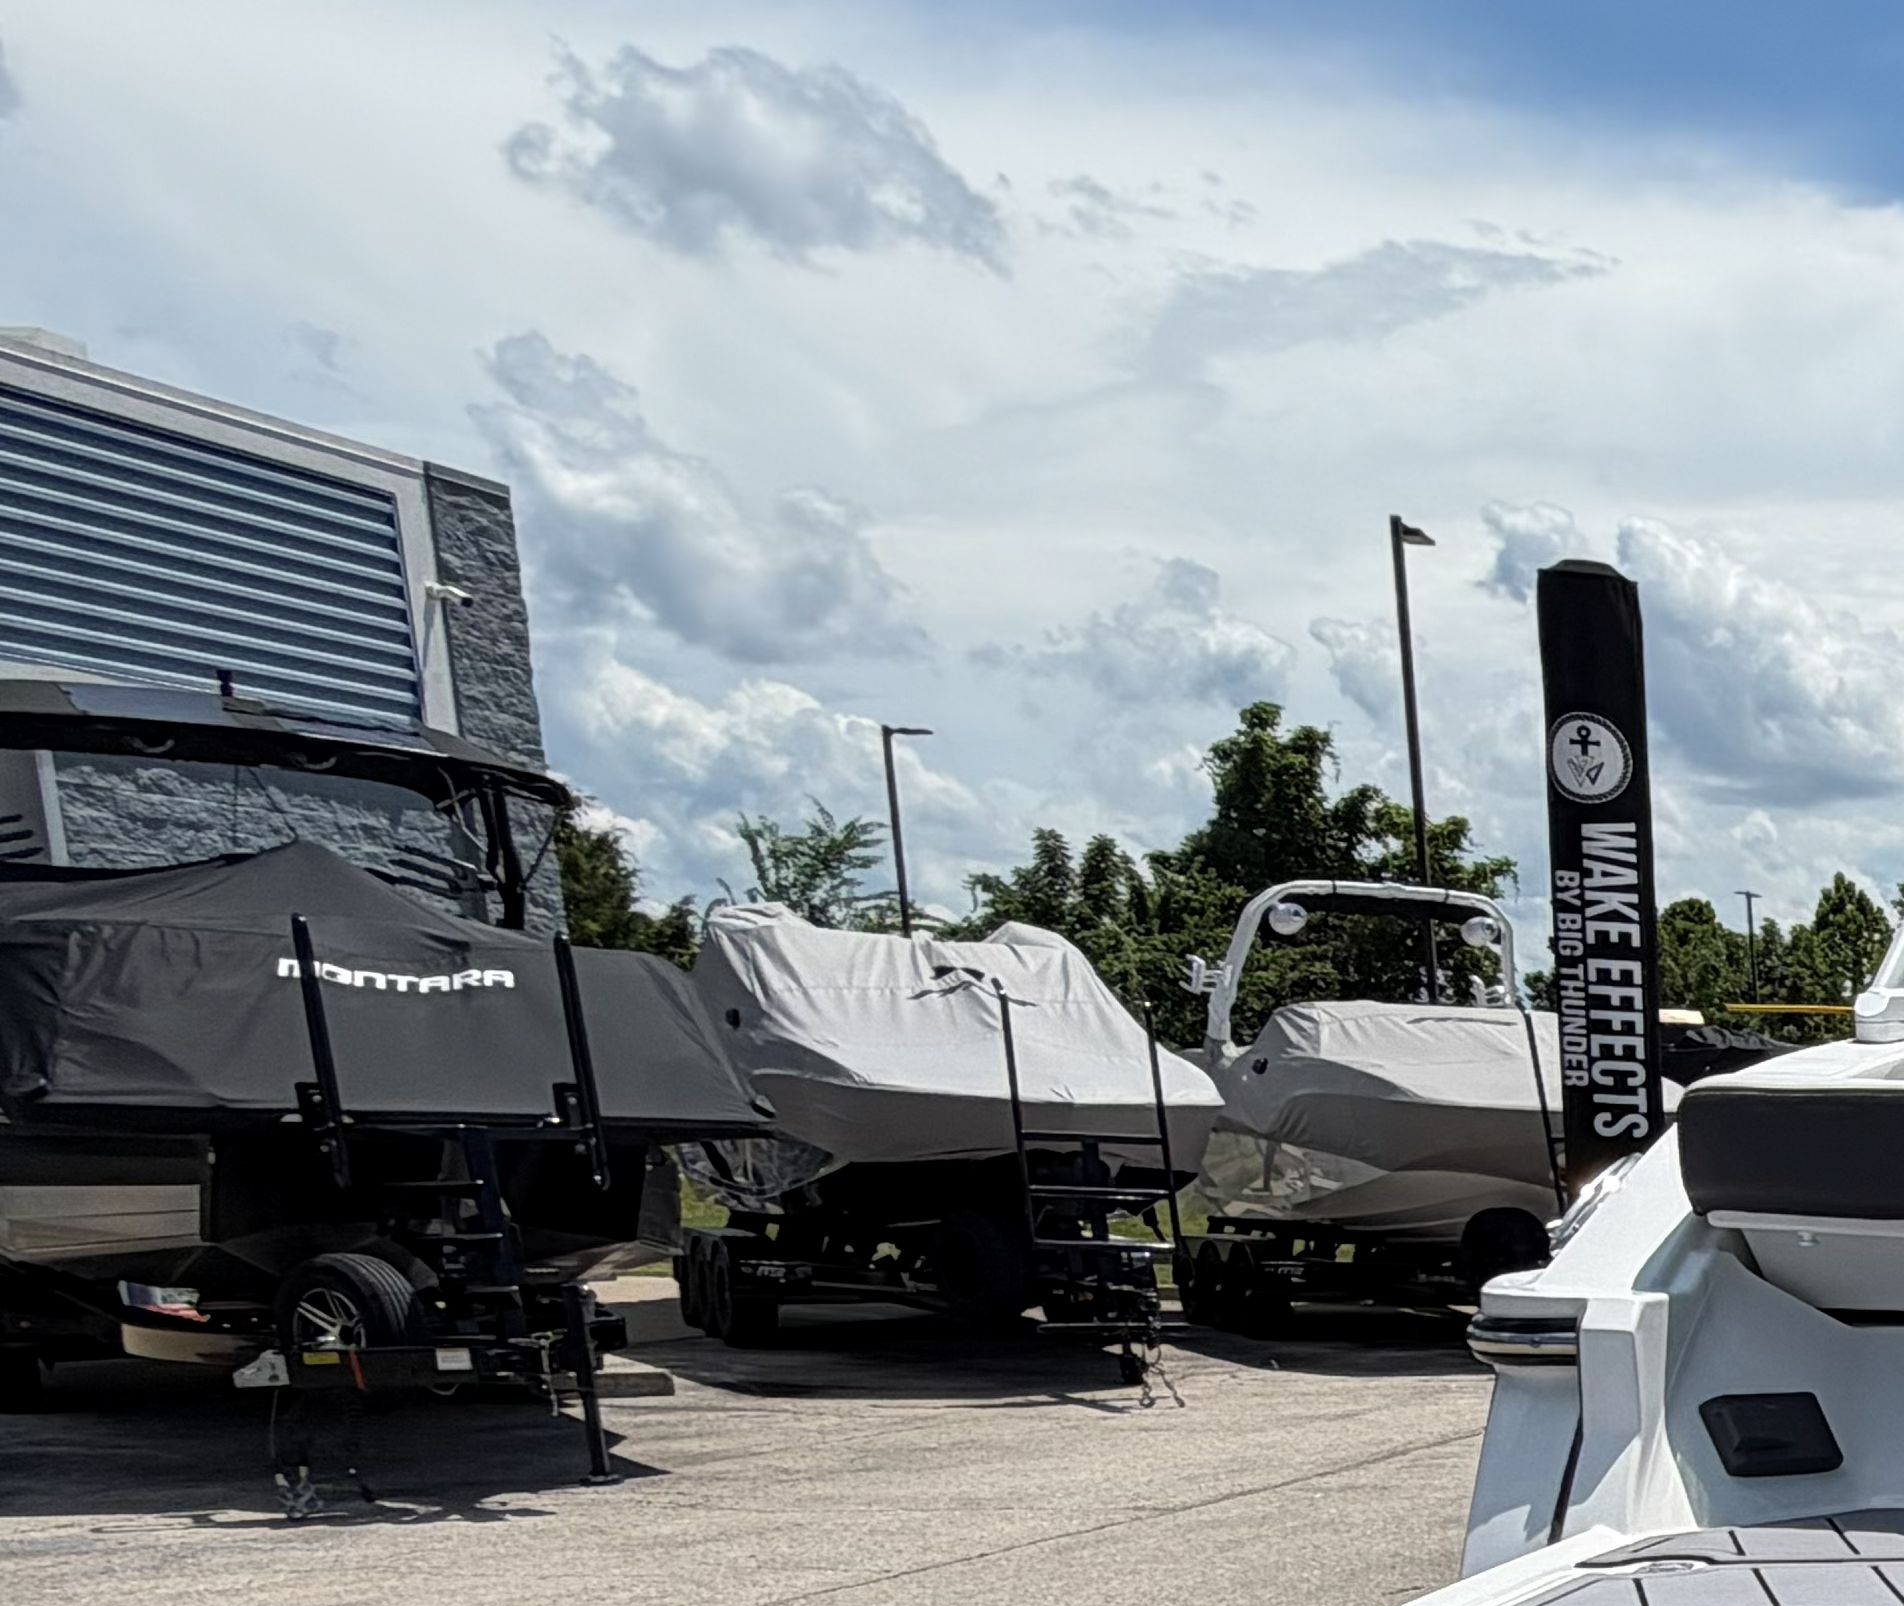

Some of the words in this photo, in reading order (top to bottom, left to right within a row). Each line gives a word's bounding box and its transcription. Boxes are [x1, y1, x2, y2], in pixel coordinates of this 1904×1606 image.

[1555, 869, 1581, 906] BY
[1581, 822, 1641, 948] WAKE
[276, 957, 516, 994] MONTARA
[1556, 912, 1584, 957] BIG
[1560, 963, 1590, 1088] THUNDER
[1587, 958, 1649, 1139] EFFECTS
